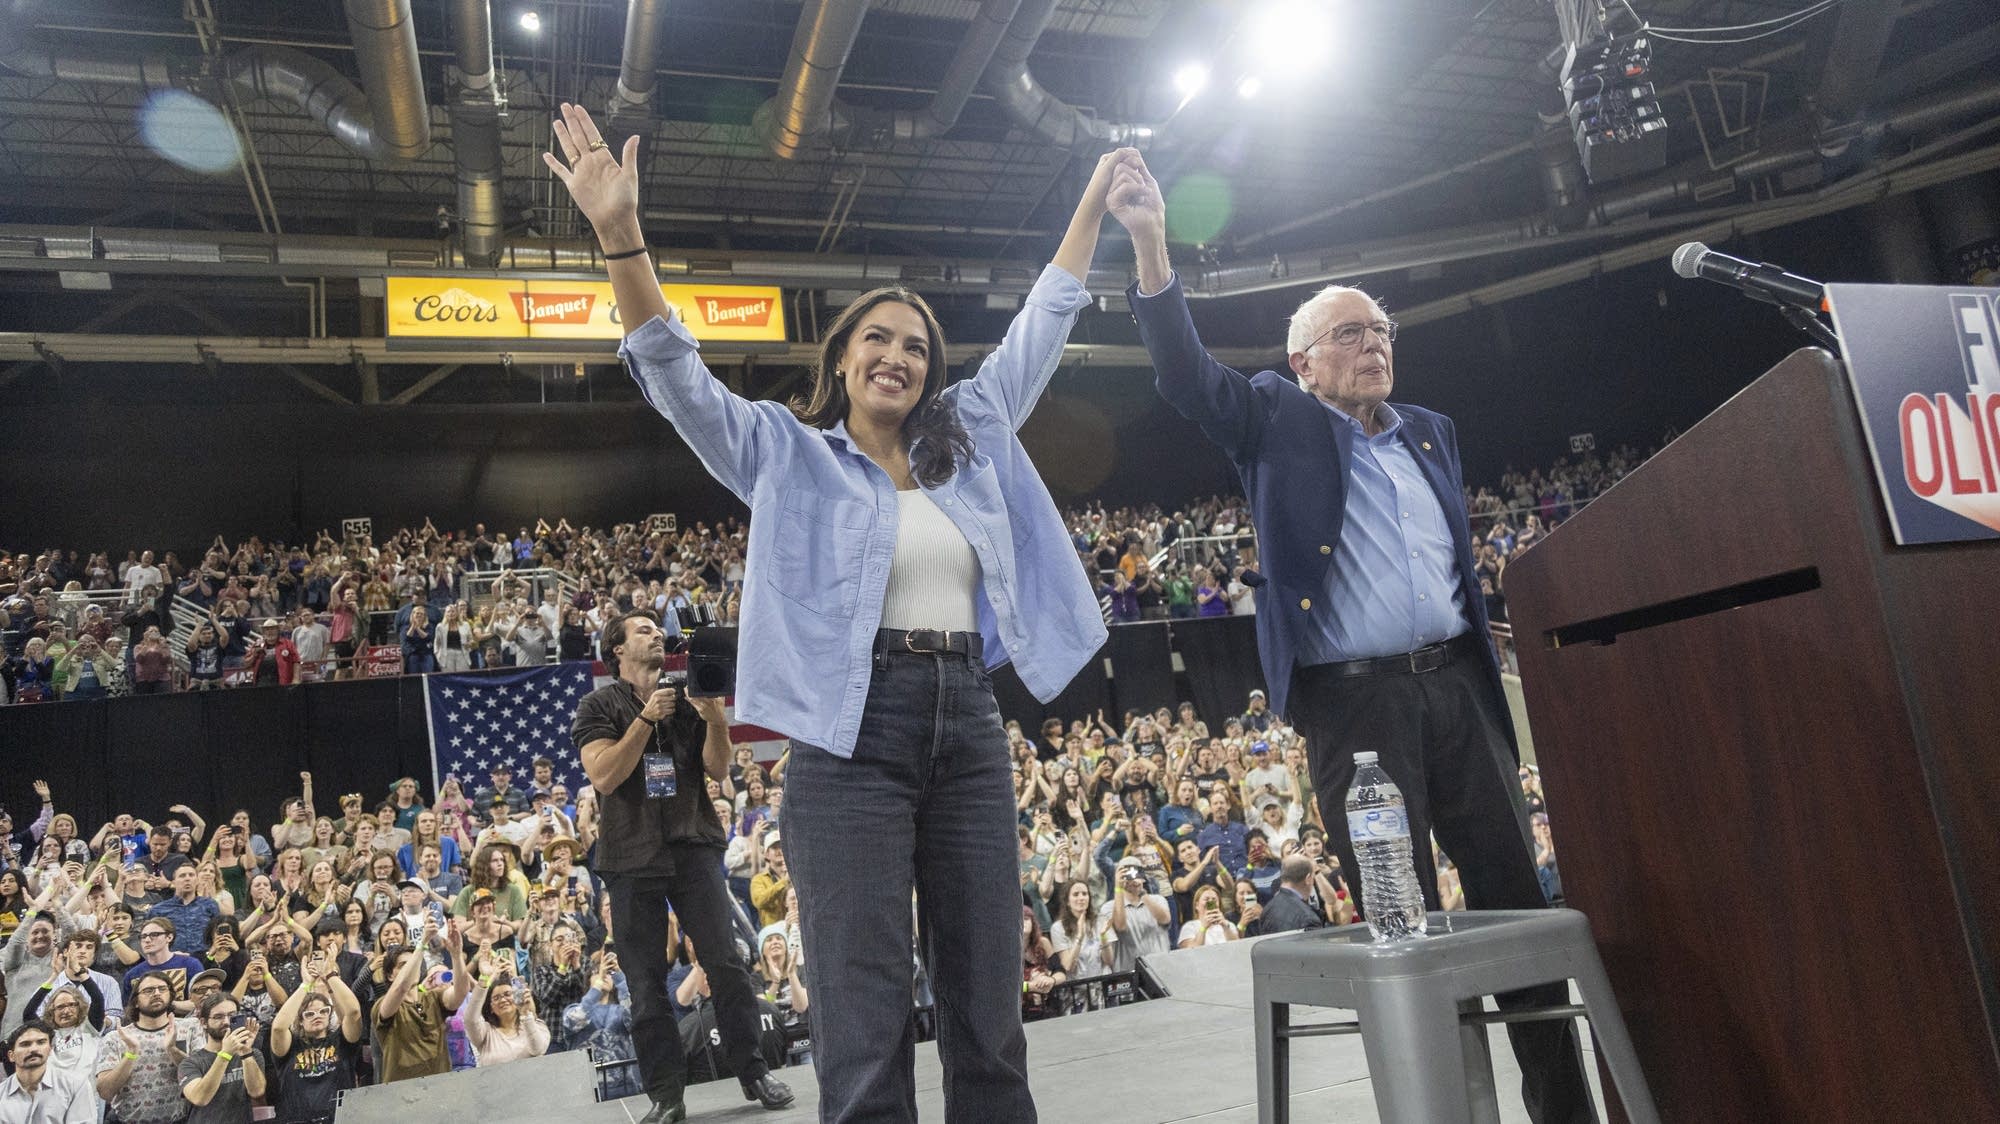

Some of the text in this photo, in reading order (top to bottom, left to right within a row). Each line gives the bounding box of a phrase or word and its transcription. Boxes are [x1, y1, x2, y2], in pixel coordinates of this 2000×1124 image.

[413, 295, 499, 322] Coors
[522, 296, 588, 321] Banquet
[707, 300, 767, 324] Banquet
[1948, 293, 2000, 390] FI
[344, 521, 371, 535] C55
[651, 516, 675, 530] C56
